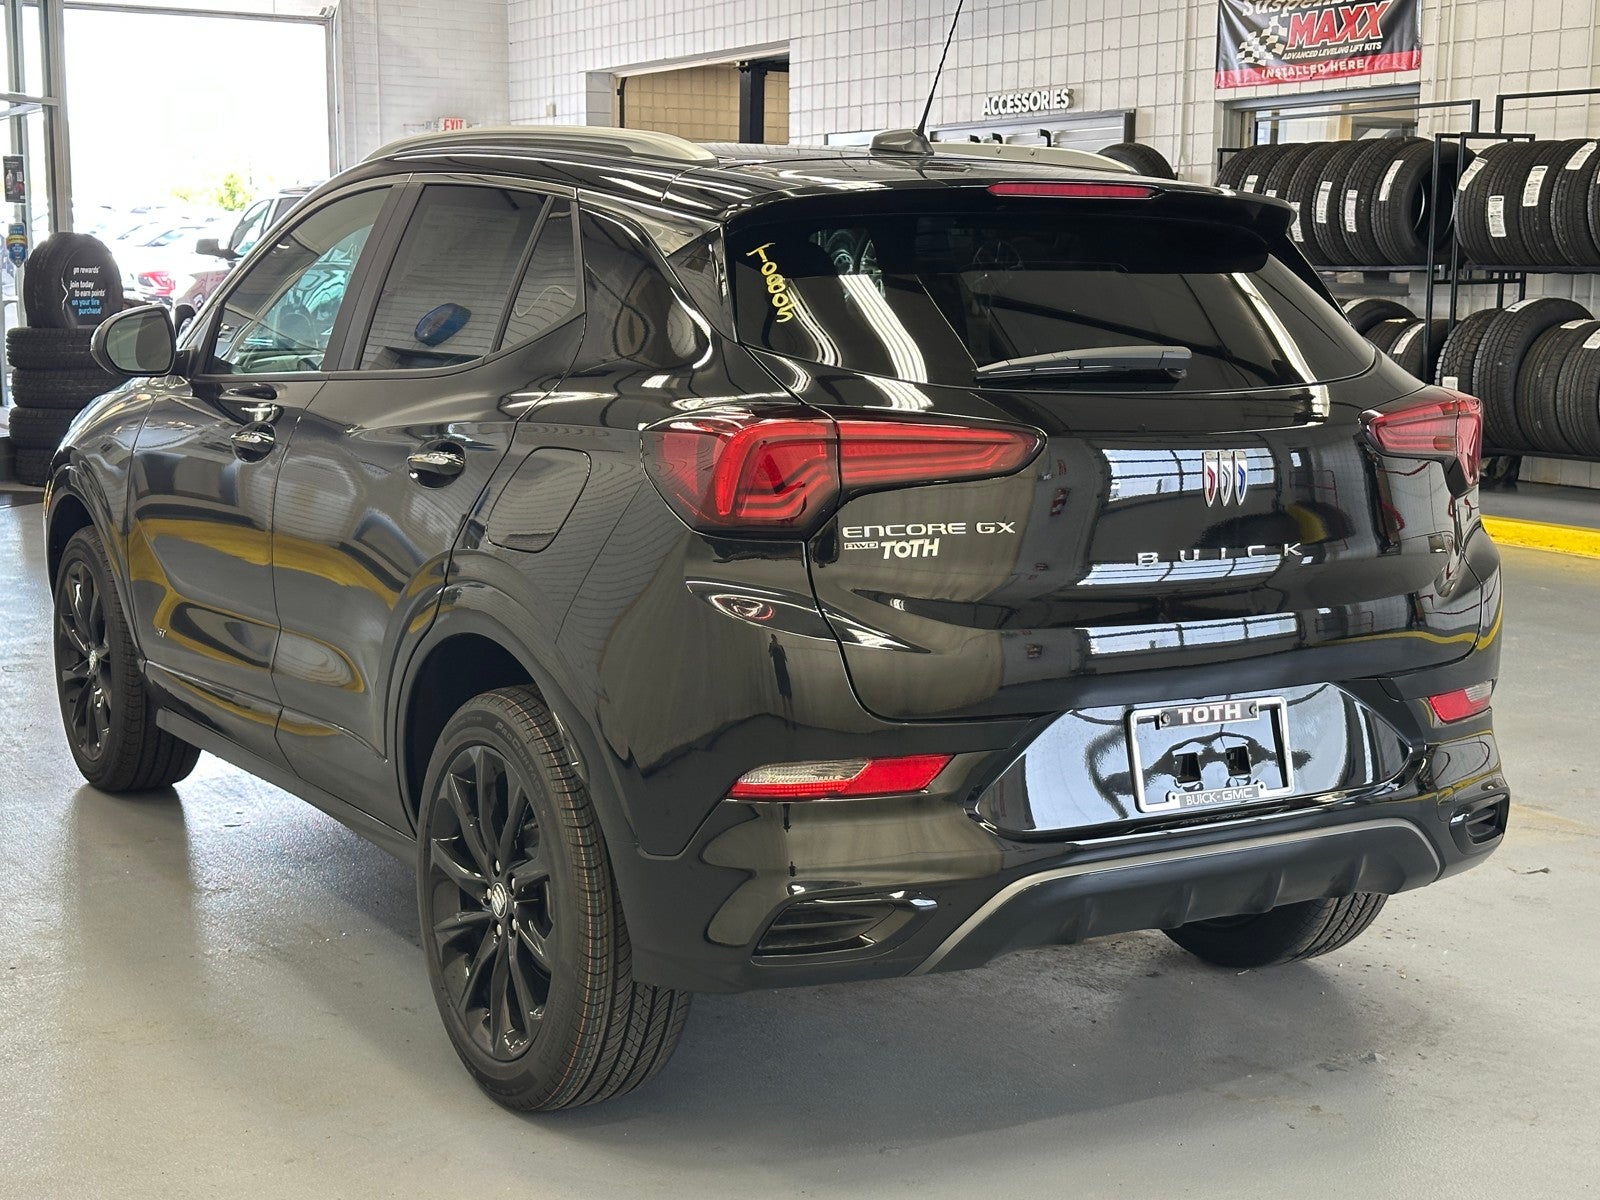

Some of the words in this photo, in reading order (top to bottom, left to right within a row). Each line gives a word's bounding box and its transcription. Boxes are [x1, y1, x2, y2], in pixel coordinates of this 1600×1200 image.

[1286, 1, 1393, 50] MAXX
[1281, 49, 1318, 60] ADVANCED
[1318, 45, 1350, 57] LEVELING
[1349, 43, 1364, 53] LIFT
[1364, 41, 1382, 51] KITS
[1261, 63, 1326, 79] INSTALLED
[1330, 59, 1365, 72] HERE
[981, 88, 1071, 116] ACCESSORIES
[443, 119, 464, 131] EXIT
[80, 266, 99, 274] rewards
[70, 280, 80, 290] join
[80, 280, 95, 290] today
[91, 289, 105, 298] points
[79, 299, 90, 307] your
[91, 298, 100, 306] tire
[78, 307, 101, 316] purchase
[842, 522, 967, 538] ENCORE
[975, 521, 1016, 534] GX
[844, 541, 878, 550] AWD
[880, 537, 941, 560] TOTH
[1136, 543, 1302, 567] BUICK
[1177, 703, 1241, 724] TOTH
